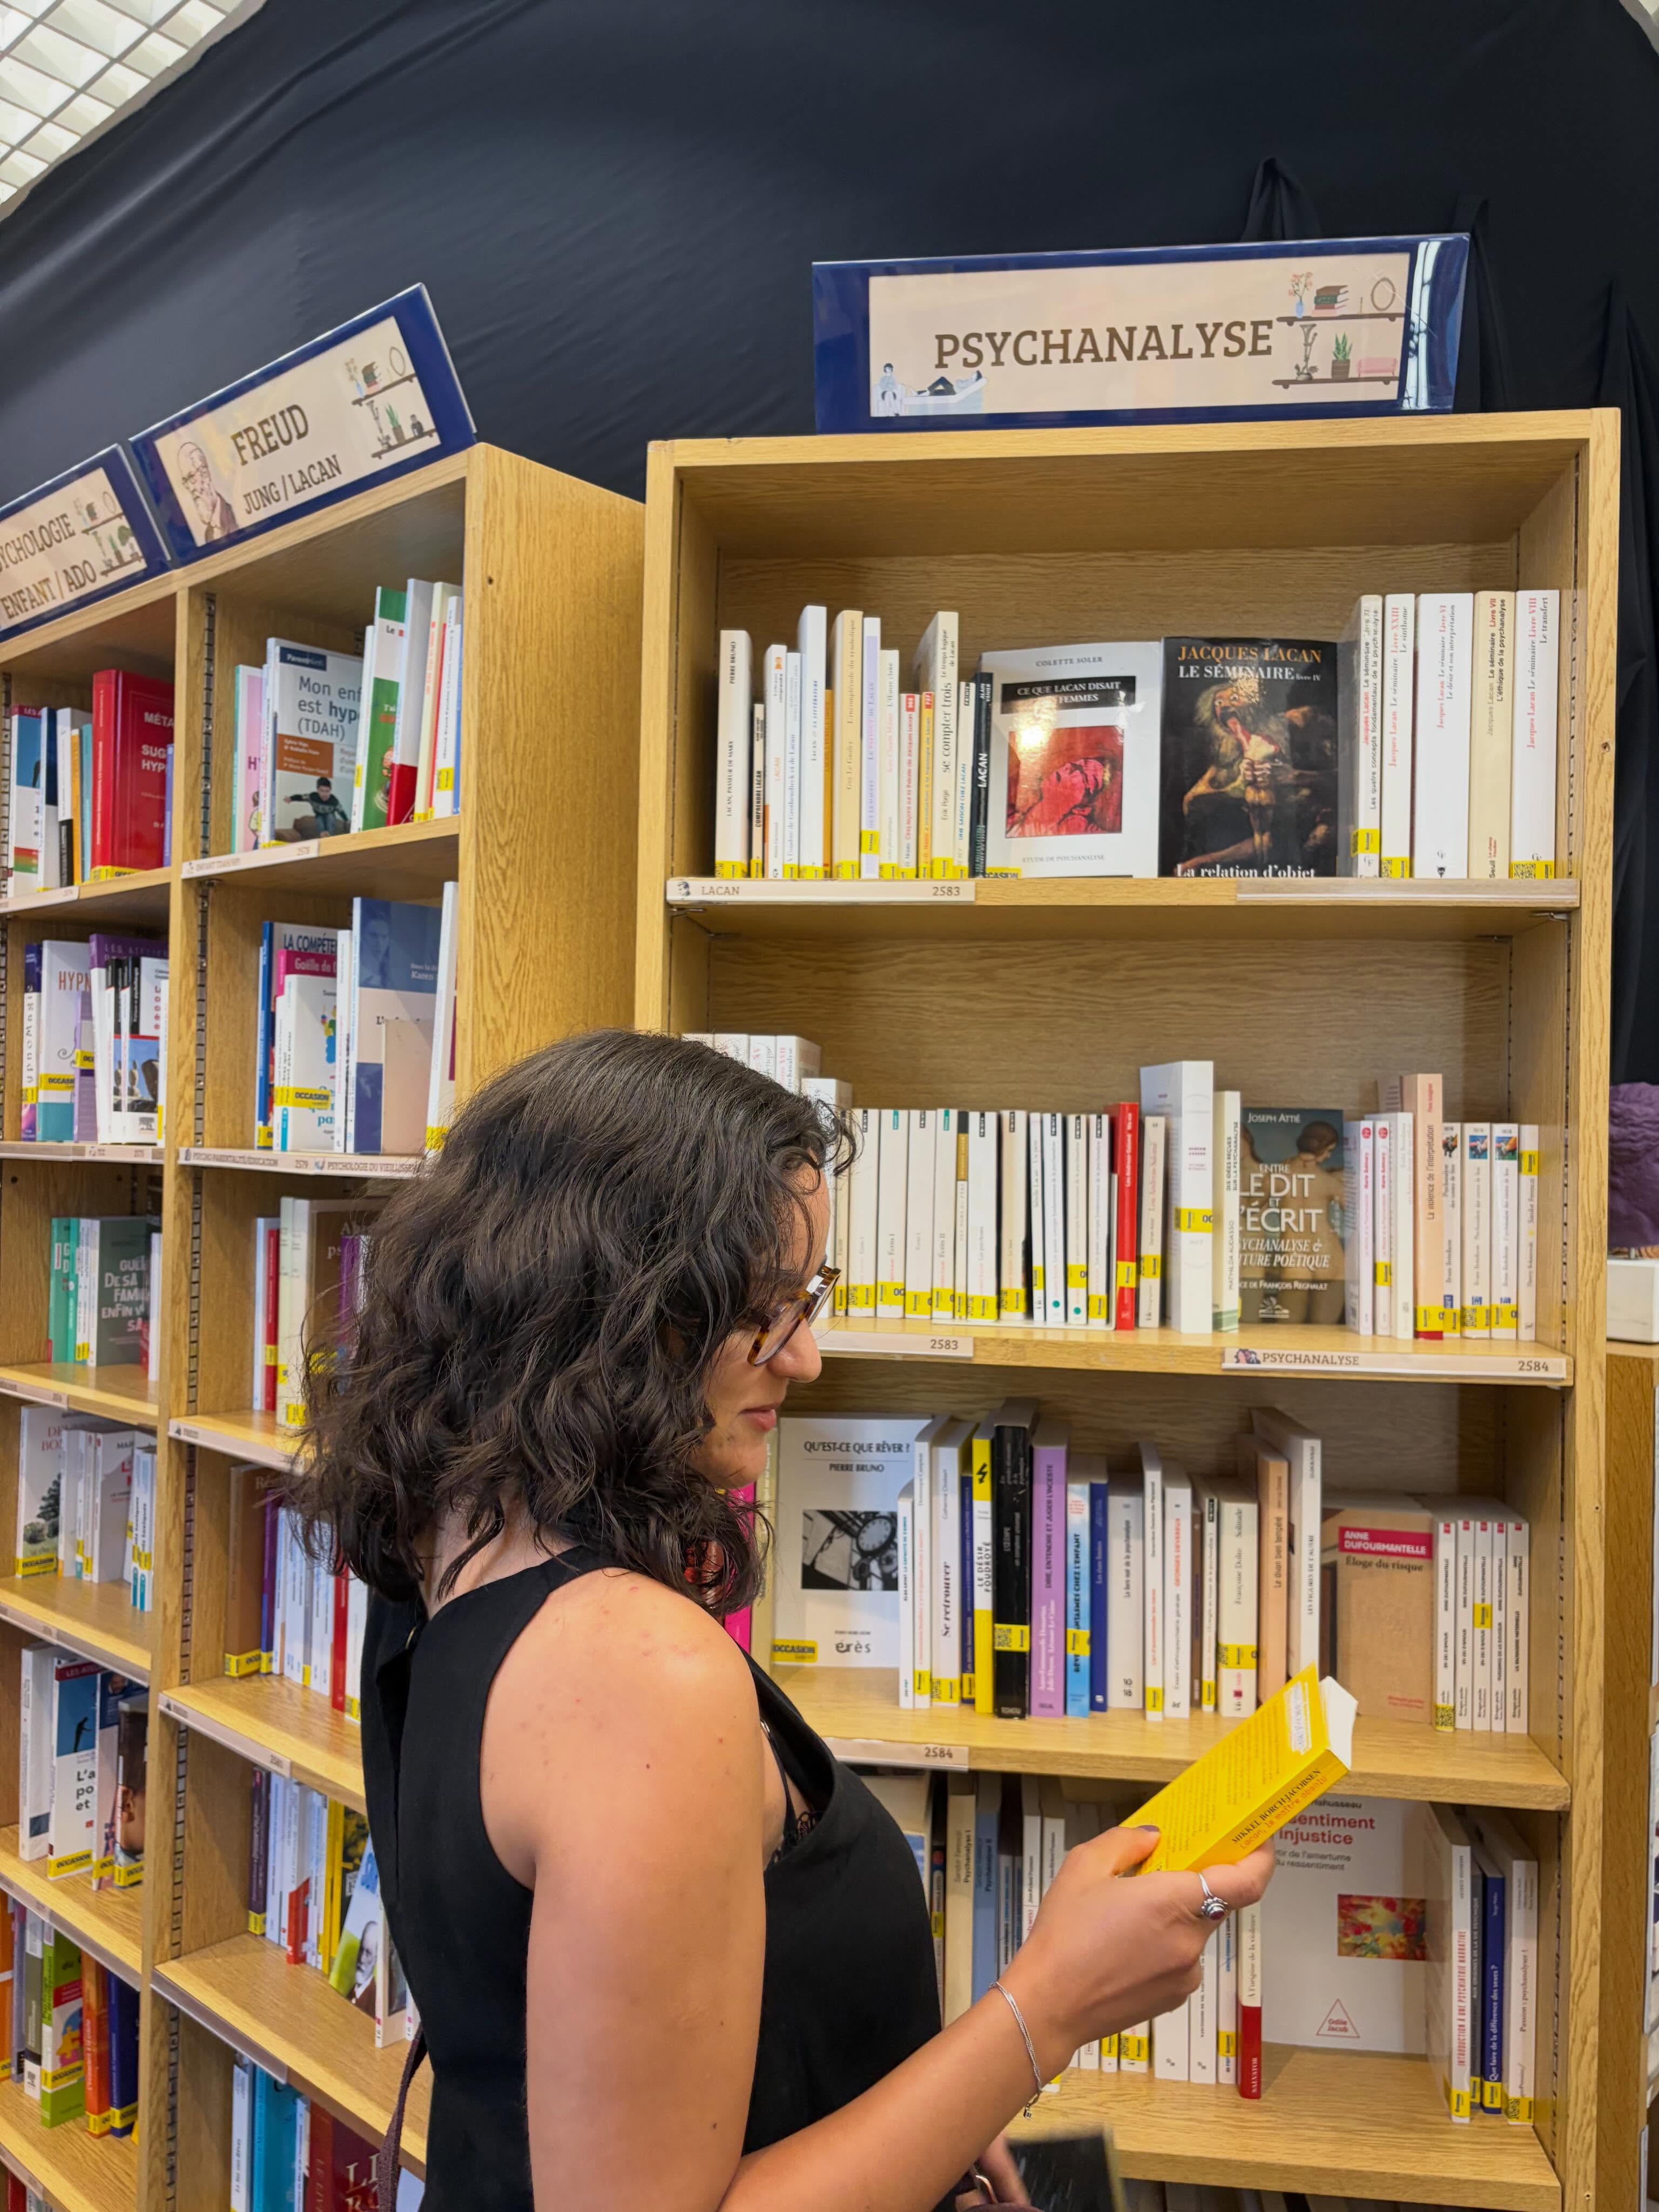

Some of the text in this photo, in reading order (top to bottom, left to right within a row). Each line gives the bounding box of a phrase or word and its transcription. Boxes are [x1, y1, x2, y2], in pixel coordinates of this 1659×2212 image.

[934, 320, 1273, 368] PSYCHANALYSE
[231, 404, 311, 466] FREUD
[243, 484, 282, 515] JUNG
[291, 455, 342, 494] LACAN
[1, 577, 56, 619] ENFANT
[63, 560, 97, 592] ADO
[1540, 597, 1548, 643] Le transfert
[1528, 617, 1536, 638] Livre
[1177, 646, 1321, 663] JACQUES LACAN
[1400, 643, 1407, 652] Le
[1036, 658, 1074, 666] COLETTE
[1498, 658, 1504, 666] de
[1528, 640, 1536, 677] séminaire
[1178, 665, 1200, 679] LE
[1203, 663, 1294, 680] SÉMINAIRE
[1372, 670, 1378, 679] de
[1488, 670, 1494, 678] Le
[299, 676, 362, 701] Mon enf
[1017, 682, 1121, 696] CE QUE LACAN DISAIT
[1528, 680, 1535, 689] Le
[940, 683, 952, 707] trois
[1059, 694, 1099, 703] FEMMES
[1390, 697, 1398, 706] Le
[298, 699, 360, 724] est hyp
[144, 712, 173, 727] MÉTA
[298, 718, 345, 741] (TDAH)
[940, 710, 953, 758] compter
[1527, 718, 1537, 749] Jacques
[1388, 737, 1397, 767] Jacques
[941, 760, 951, 772] se
[978, 753, 987, 787] LACAN
[1176, 864, 1316, 878] La relation d'objet
[702, 886, 740, 895] LACAN
[933, 886, 960, 896] 2583
[284, 933, 337, 954] LA COMPÉTE
[58, 971, 91, 990] HYPN
[295, 1092, 329, 1101] OCCASION
[1247, 1113, 1277, 1123] JOSEPH
[1426, 1124, 1435, 1171] l'interprétation
[1259, 1164, 1290, 1172] ENTRE
[1270, 1174, 1316, 1198] DIT
[1269, 1197, 1280, 1207] ET
[1426, 1184, 1434, 1209] violence
[1239, 1201, 1323, 1233] 'ÉCRIT
[1239, 1238, 1311, 1252] YCHANALYSE
[1273, 1252, 1330, 1271] POÉTIQUE
[1259, 1280, 1292, 1290] FRANÇOIS
[930, 1339, 959, 1351] 2583
[1263, 1353, 1359, 1366] PSYCHANALYSE
[1518, 1361, 1549, 1372] 2584
[804, 1441, 850, 1453] QU'EST-CE
[853, 1442, 873, 1454] QUE
[875, 1440, 903, 1452] RÊVER
[830, 1464, 884, 1472] PIERRE BRUNO
[1046, 1523, 1053, 1532] ET
[1345, 1532, 1368, 1540] ANNE
[1344, 1541, 1426, 1555] DUFOURMANTELLE
[983, 1542, 992, 1592] FOUDROYÉ
[1345, 1557, 1423, 1573] Éloge du risque
[976, 1577, 983, 1587] LE
[941, 1562, 952, 1637] Se retrouver
[835, 1640, 871, 1653] érès
[925, 1747, 953, 1759] 2584
[76, 1799, 90, 1811] et
[1232, 1820, 1260, 1844] MIKKEL
[1259, 1769, 1321, 1820] BORCH-JACOBSEN
[1240, 1830, 1266, 1849] Lacan,
[1301, 1776, 1327, 1798] absolu
[1287, 1860, 1345, 1870] ressentiment
[1457, 1931, 1466, 1963] NARRATIVE
[1457, 1966, 1466, 2002] PSYCHIATRIE
[1458, 2005, 1466, 2015] UNE
[1457, 2024, 1467, 2066] INTRODUCTION
[1489, 2067, 1499, 2081] Que
